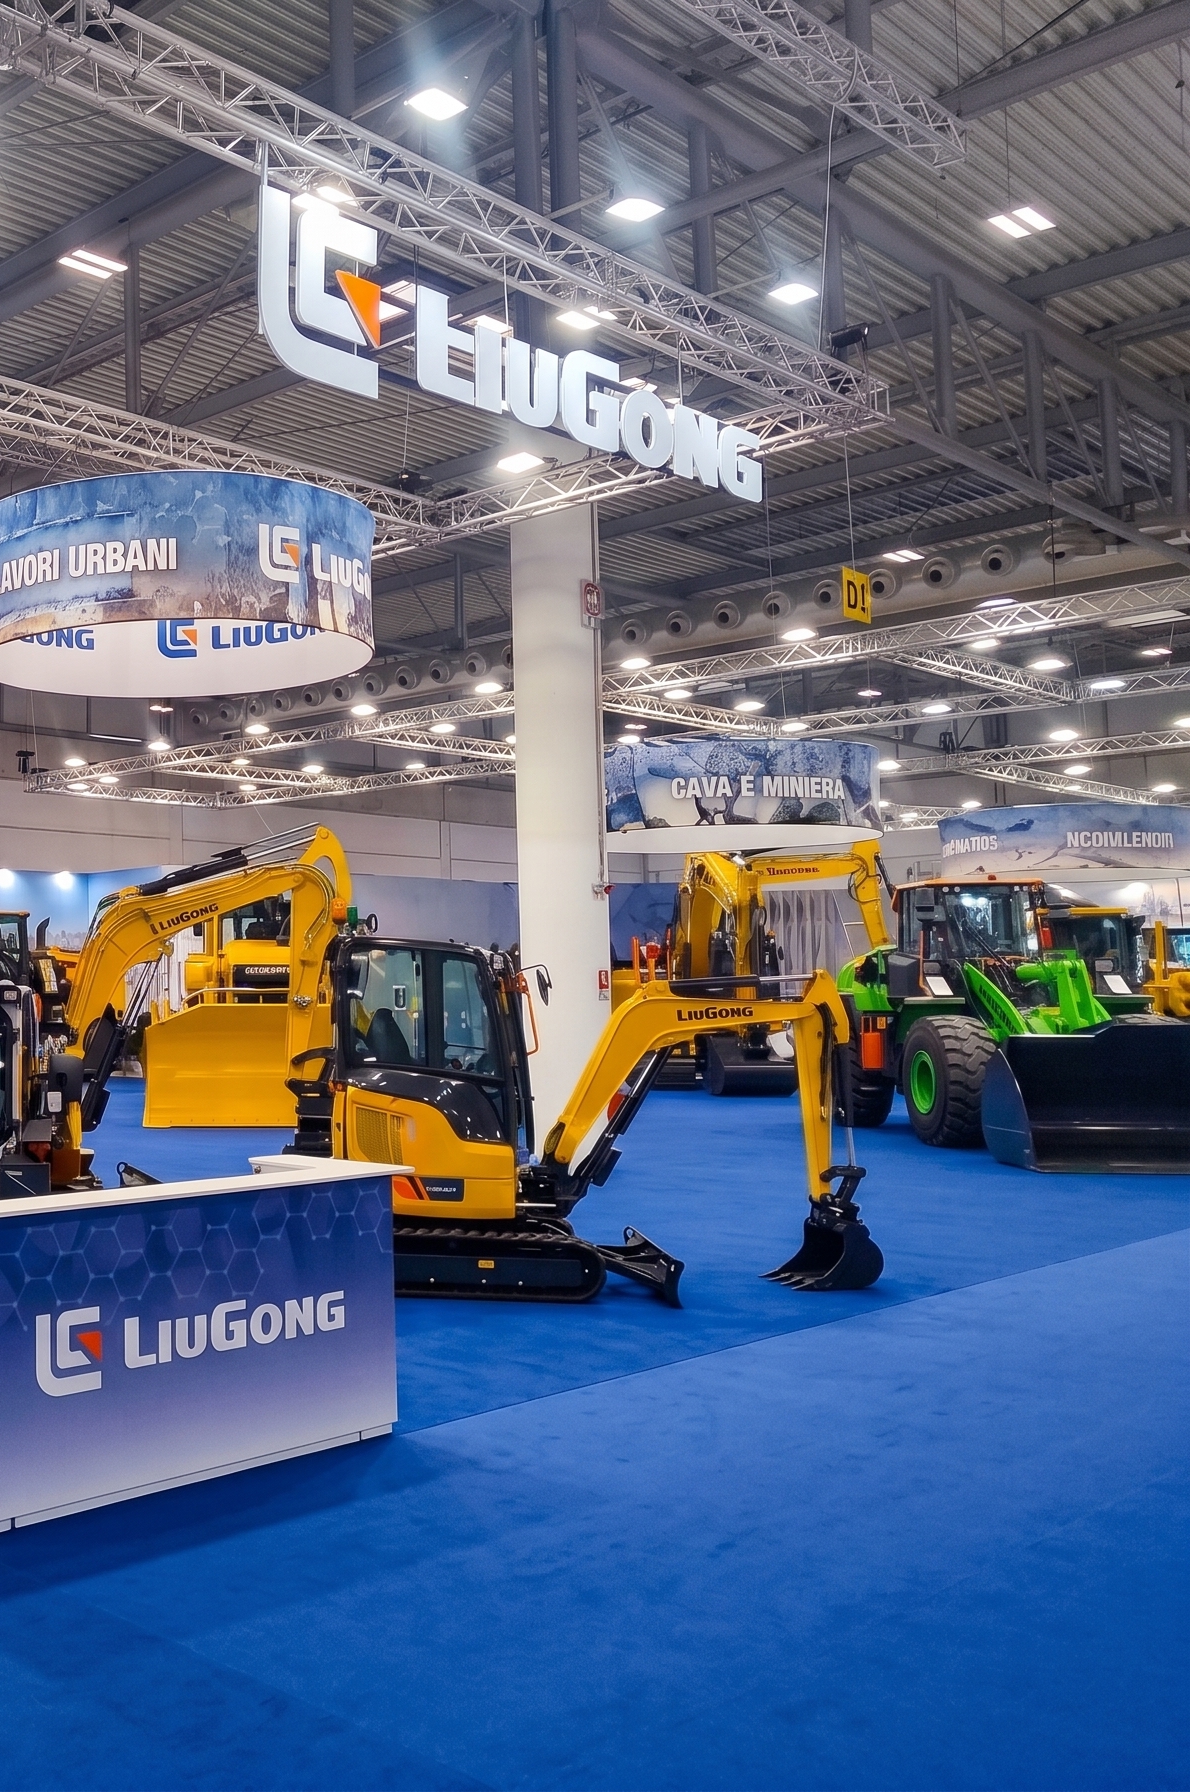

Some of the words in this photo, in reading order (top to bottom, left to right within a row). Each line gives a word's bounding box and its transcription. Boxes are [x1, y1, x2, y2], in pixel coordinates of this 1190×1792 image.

[68, 537, 178, 578] URBANI
[671, 776, 733, 799] CAVA
[762, 776, 846, 800] MINIERA
